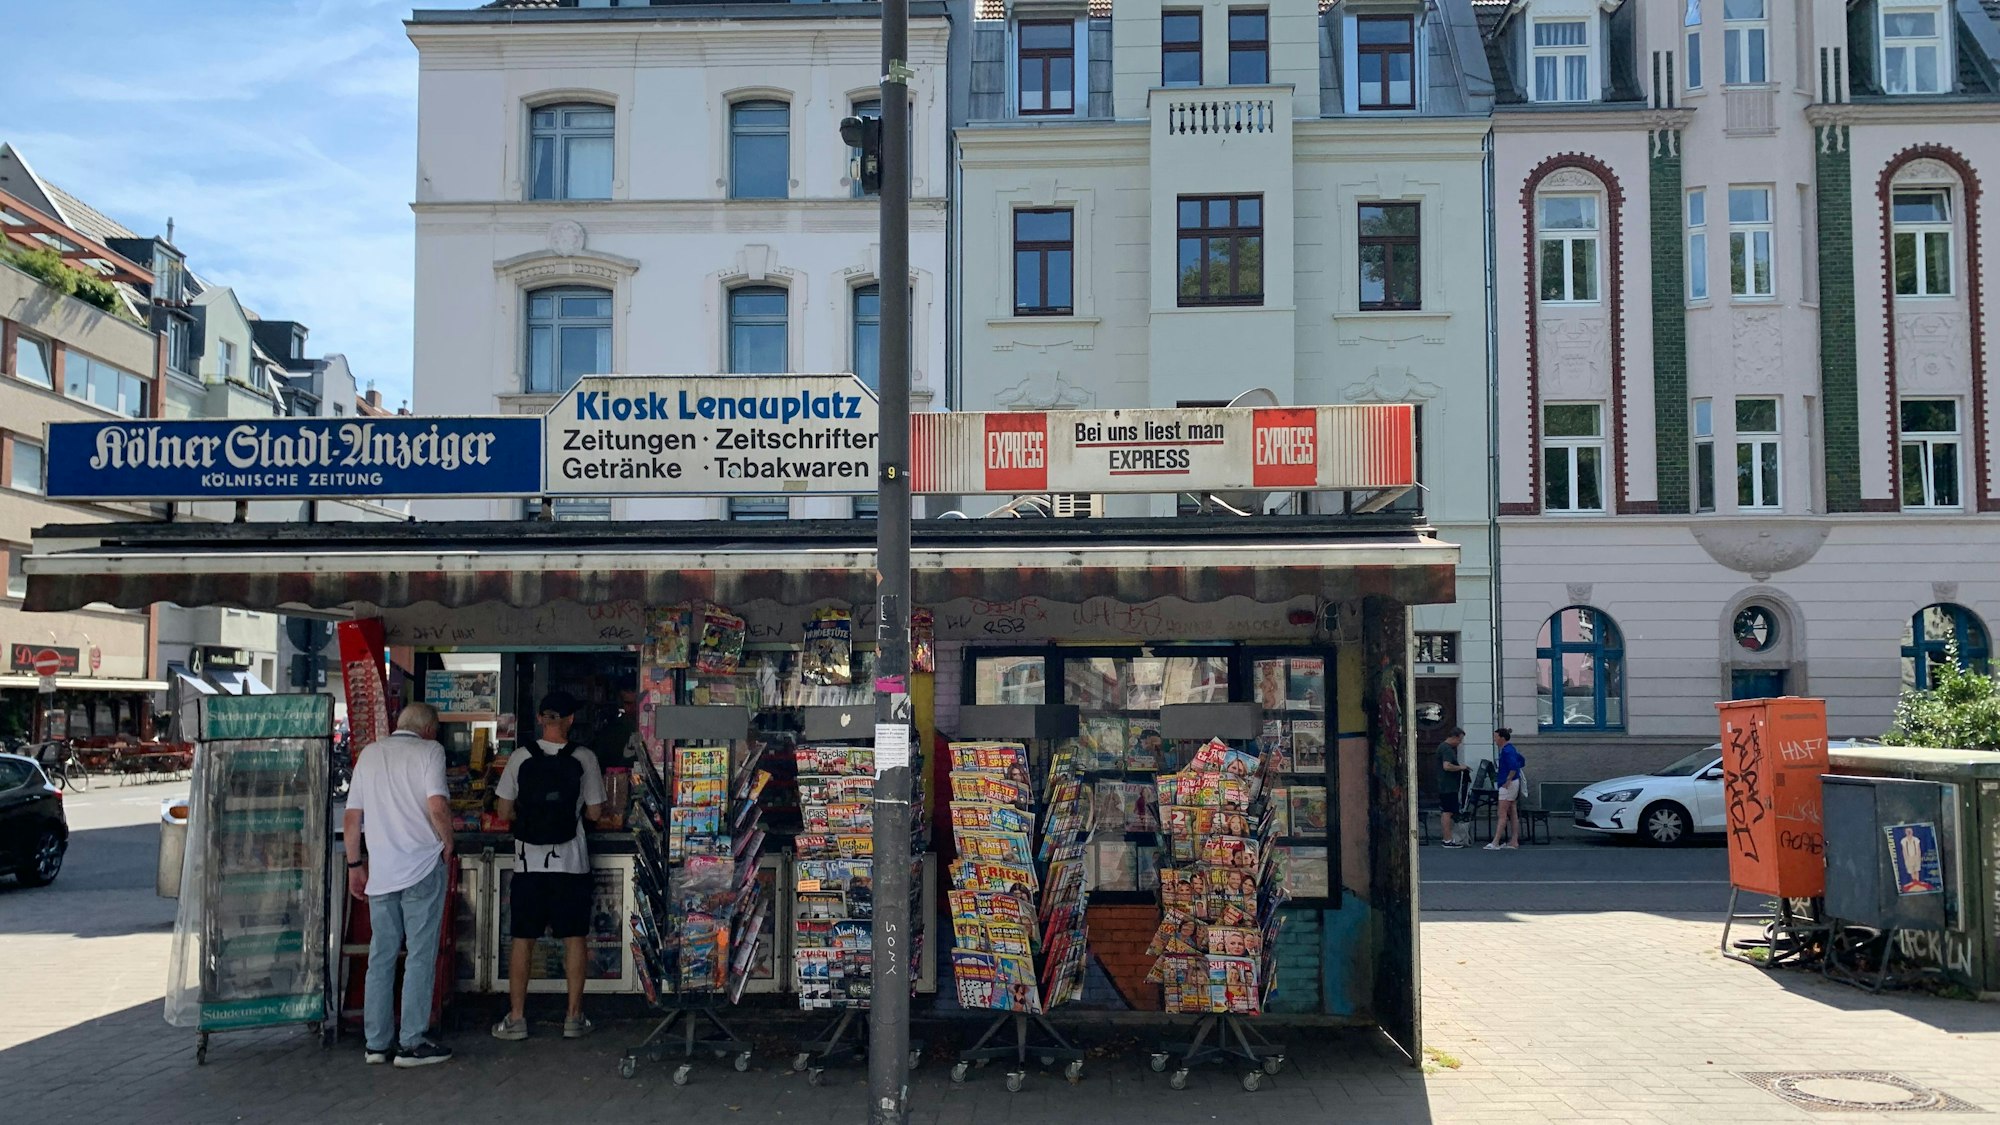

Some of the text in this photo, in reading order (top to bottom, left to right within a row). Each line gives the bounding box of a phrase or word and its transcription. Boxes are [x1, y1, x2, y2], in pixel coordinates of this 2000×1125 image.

[577, 390, 861, 424] Kiosk Lenauplatz
[563, 429, 696, 454] Zeitungen
[1075, 421, 1224, 441] Bei uns liest man
[89, 423, 496, 471] Kölner Stadt-Anzeiger
[988, 431, 1044, 469] EXPRESS
[1109, 448, 1190, 469] EXPRESS
[1256, 427, 1313, 465] EXPRESS
[201, 472, 384, 487] KÖLNISCHE ZEITUNG
[562, 457, 869, 479] Getränke Tabakwaren
[887, 466, 896, 479] 9
[886, 921, 897, 974] SONY
